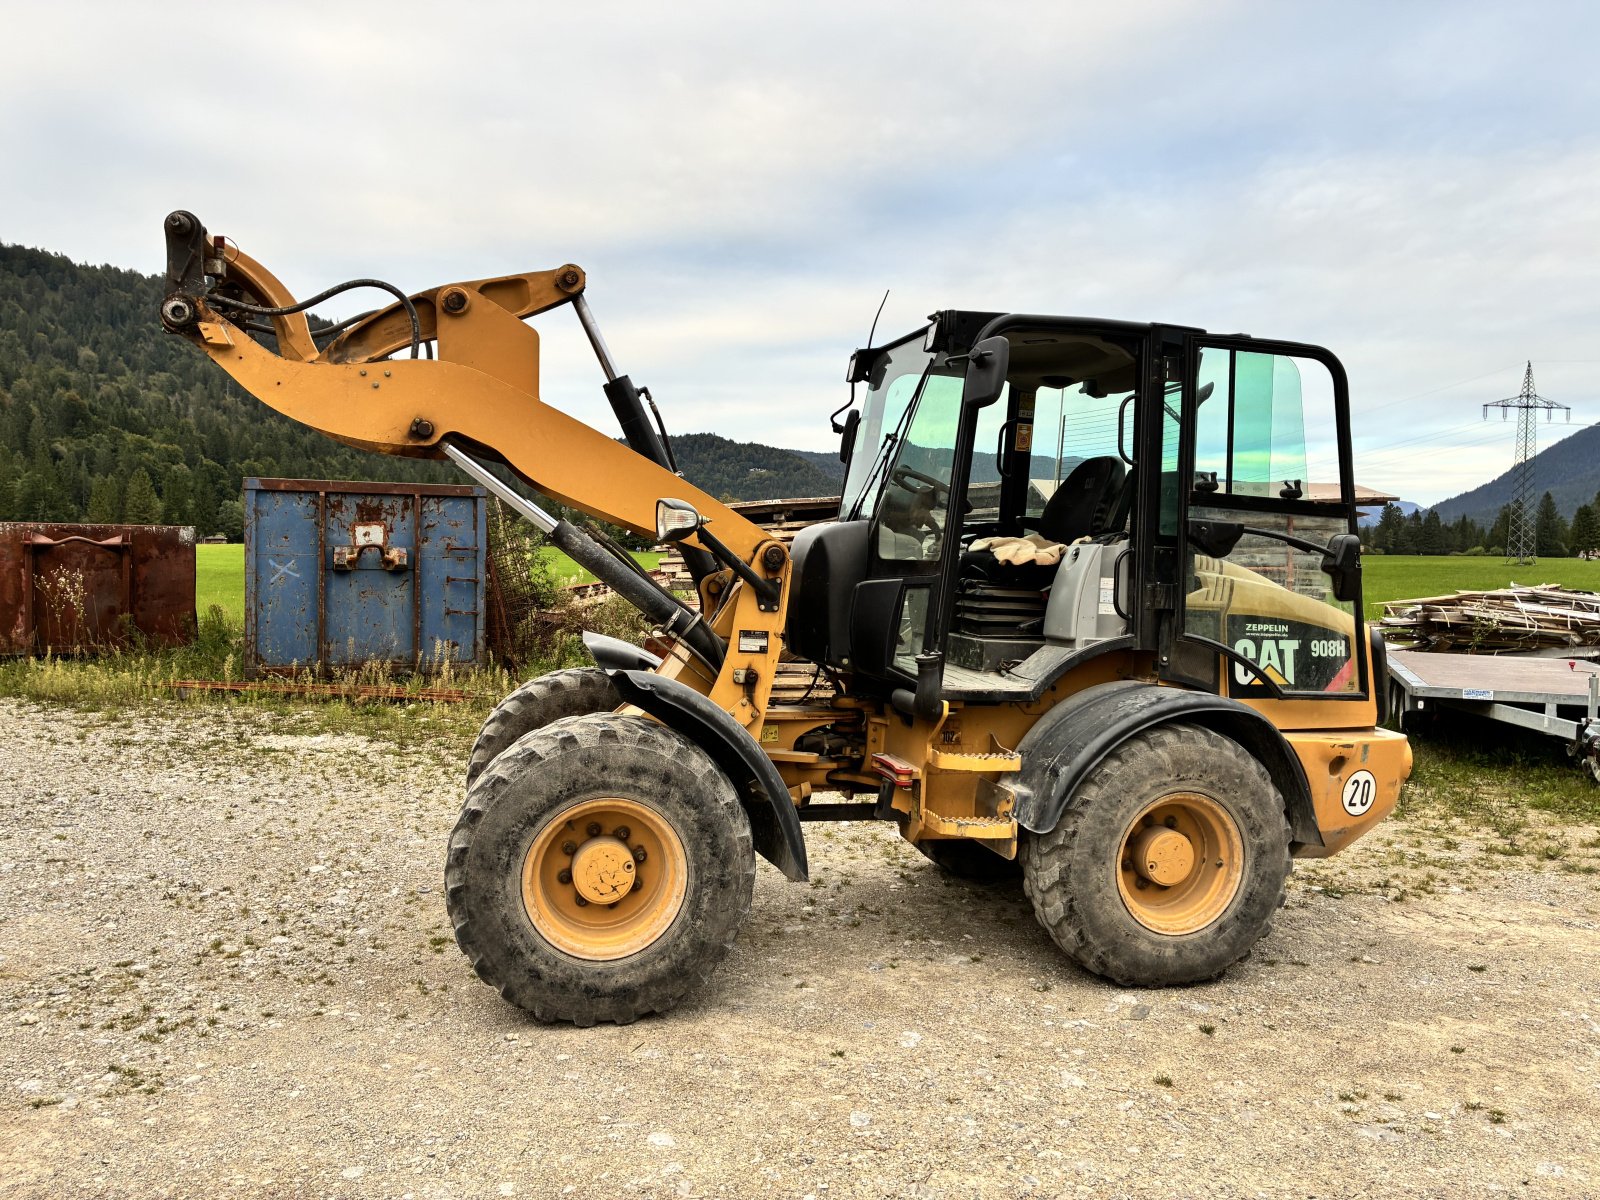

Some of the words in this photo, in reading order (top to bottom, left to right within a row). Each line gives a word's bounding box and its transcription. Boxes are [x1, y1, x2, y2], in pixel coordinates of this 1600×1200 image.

[1245, 623, 1289, 633] ZEPPELIN
[1310, 639, 1346, 657] 908H
[1234, 638, 1300, 686] CAT
[1348, 779, 1371, 807] 20
